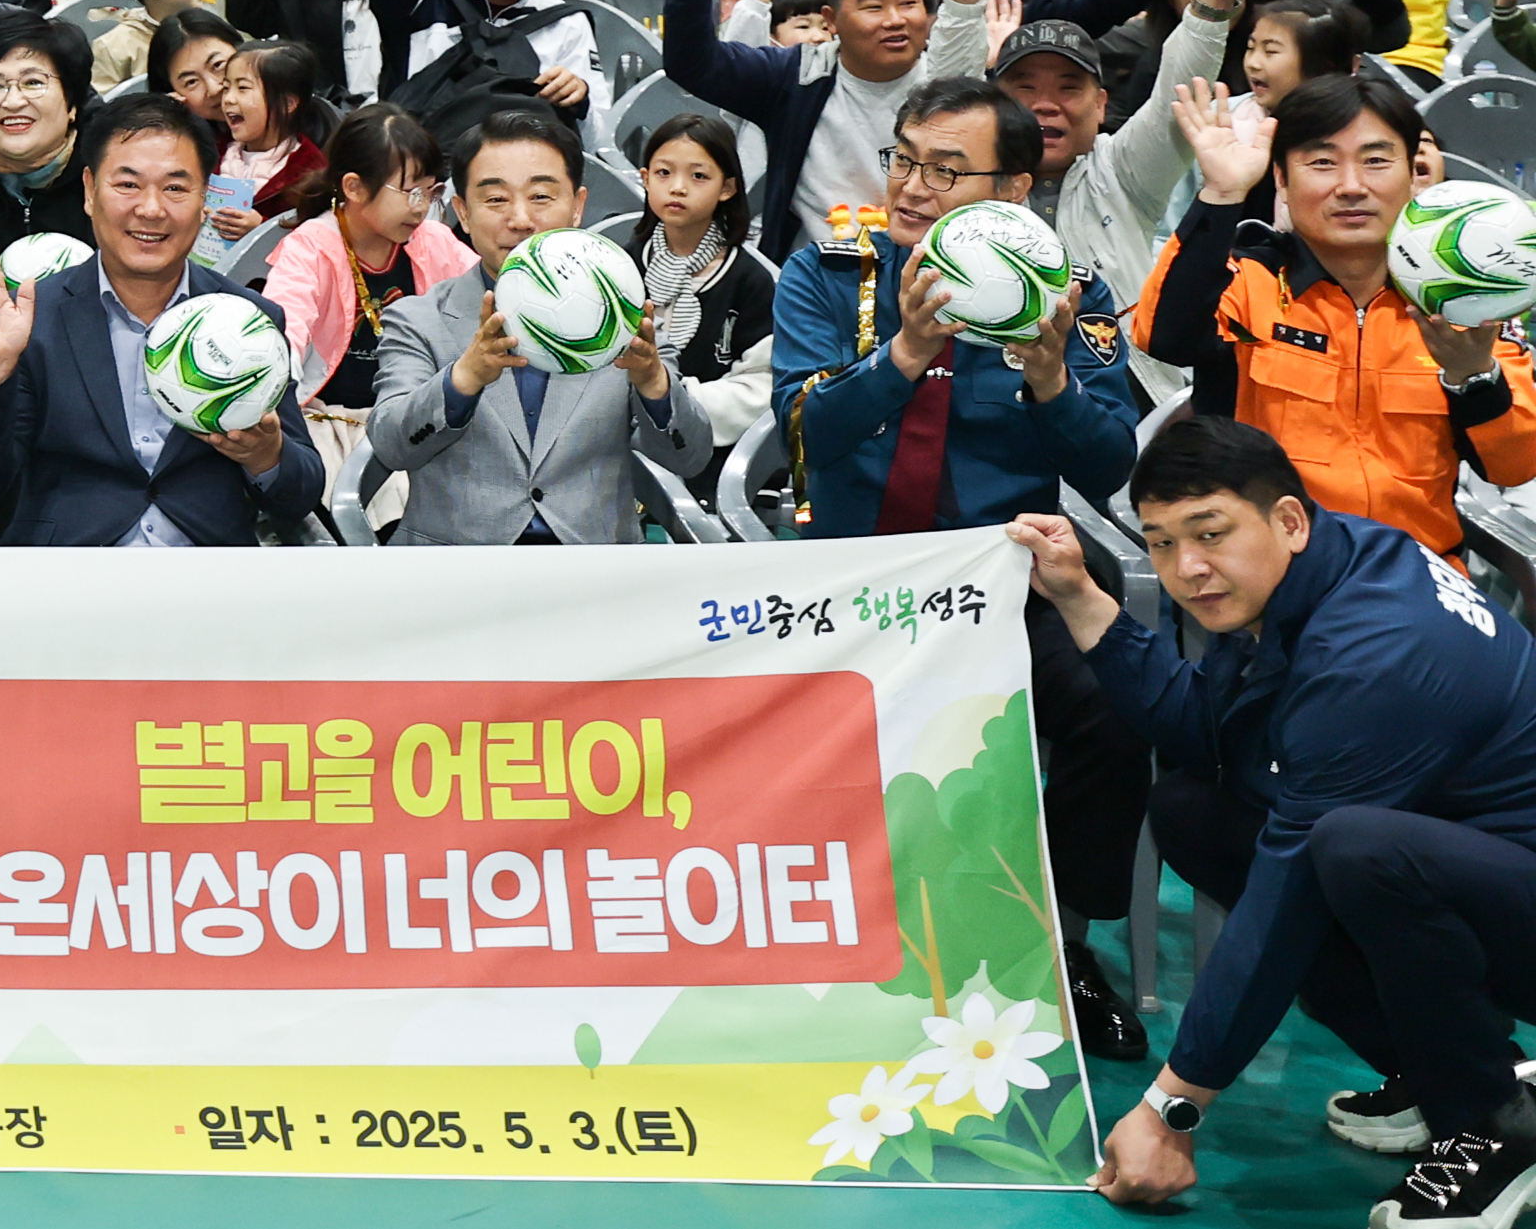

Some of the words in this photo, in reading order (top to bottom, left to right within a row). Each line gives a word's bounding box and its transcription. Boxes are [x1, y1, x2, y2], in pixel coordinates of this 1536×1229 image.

[698, 595, 835, 642] 군민중심
[852, 584, 986, 645] 행복성주
[134, 719, 376, 825] 별고을
[390, 717, 693, 831] 어린이,
[383, 847, 574, 953] 너의
[585, 840, 860, 956] 놀이터
[198, 1105, 295, 1151] 일자
[350, 1109, 485, 1154] 2025.
[503, 1110, 552, 1155] 5.
[568, 1106, 698, 1157] 3.(토)
